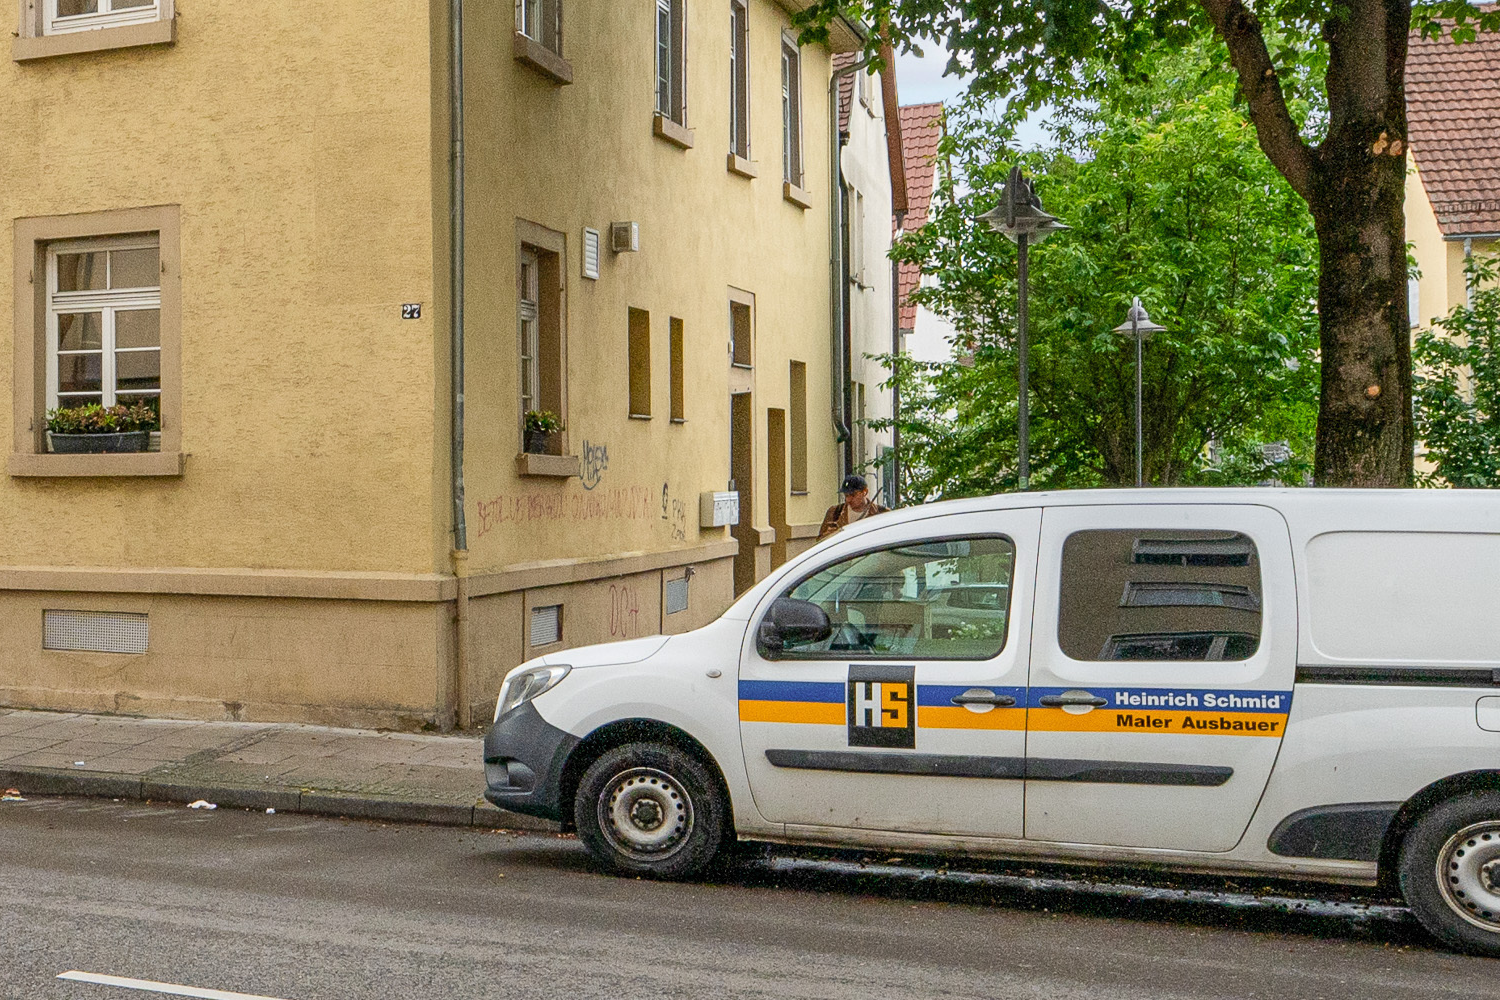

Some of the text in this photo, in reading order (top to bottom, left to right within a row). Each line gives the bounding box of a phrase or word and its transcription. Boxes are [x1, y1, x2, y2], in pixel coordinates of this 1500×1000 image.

[403, 304, 420, 318] 27
[855, 682, 908, 728] HS
[1115, 691, 1199, 707] Heinrich
[1116, 714, 1279, 731] Maler Ausbauer
